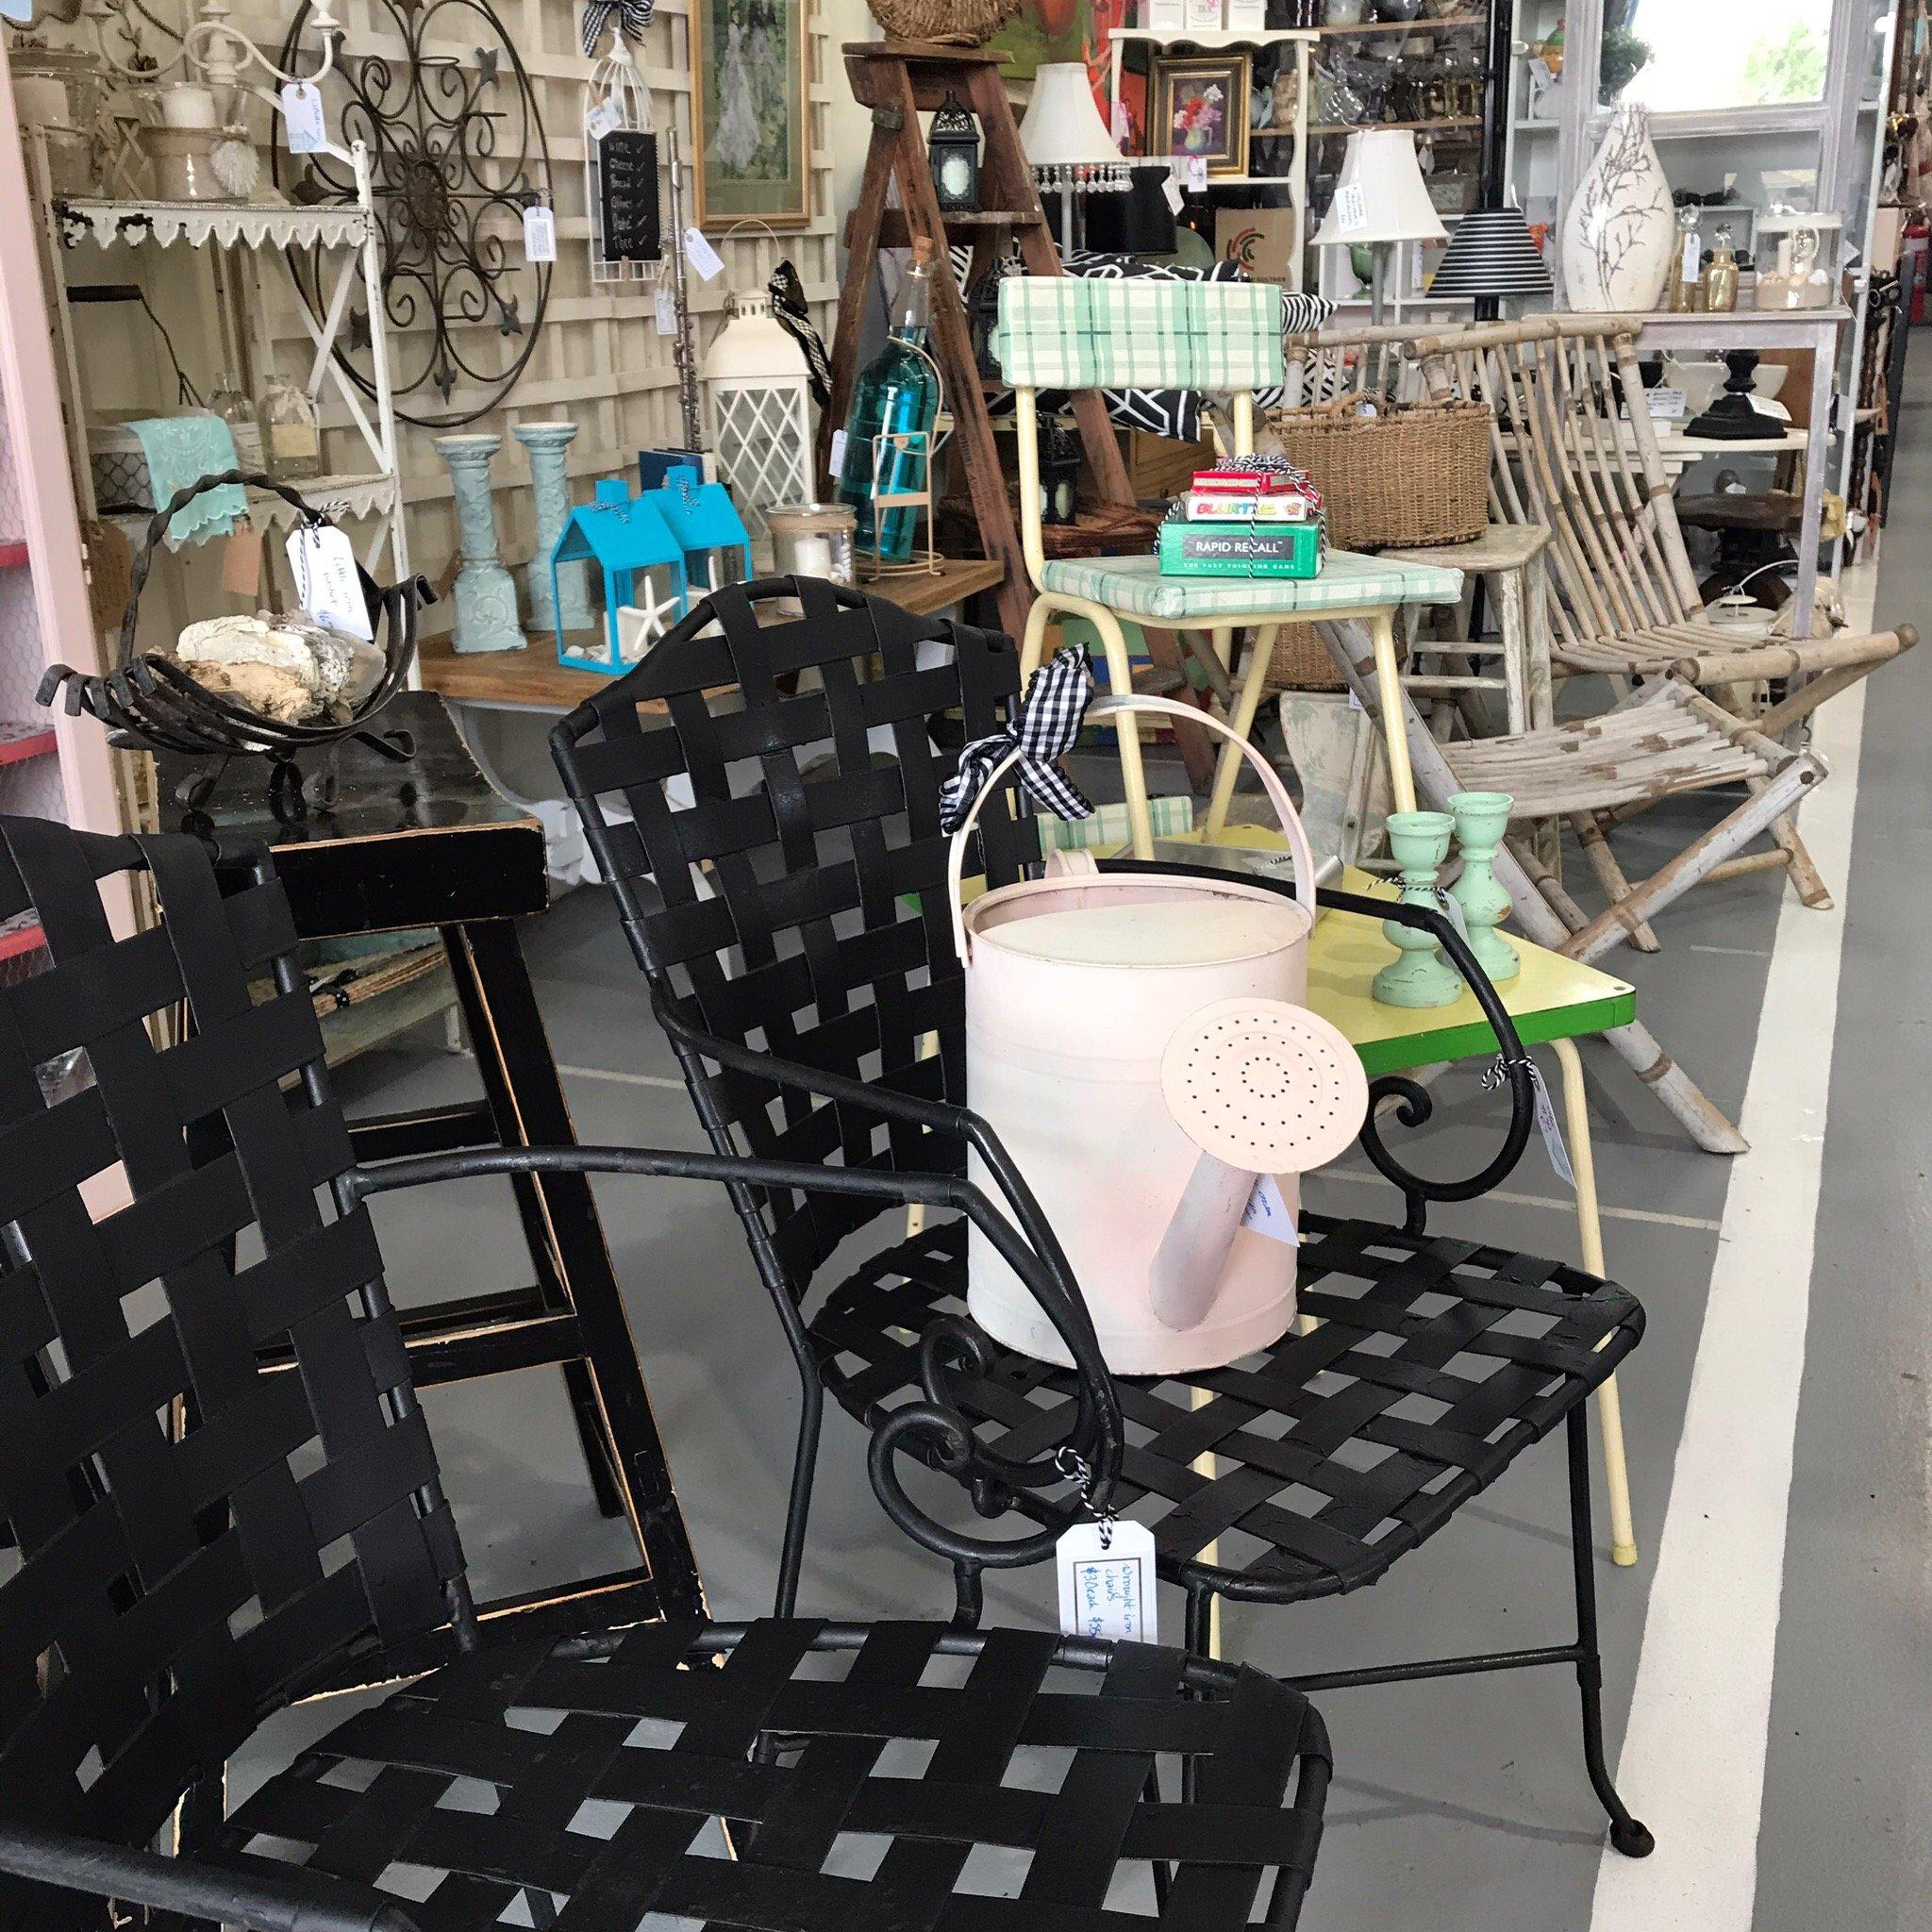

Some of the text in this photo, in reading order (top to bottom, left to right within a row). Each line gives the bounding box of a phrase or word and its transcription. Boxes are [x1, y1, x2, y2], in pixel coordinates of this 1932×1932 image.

[1195, 541, 1279, 553] RAPID RECALL
[1123, 1612, 1136, 1634] iron
